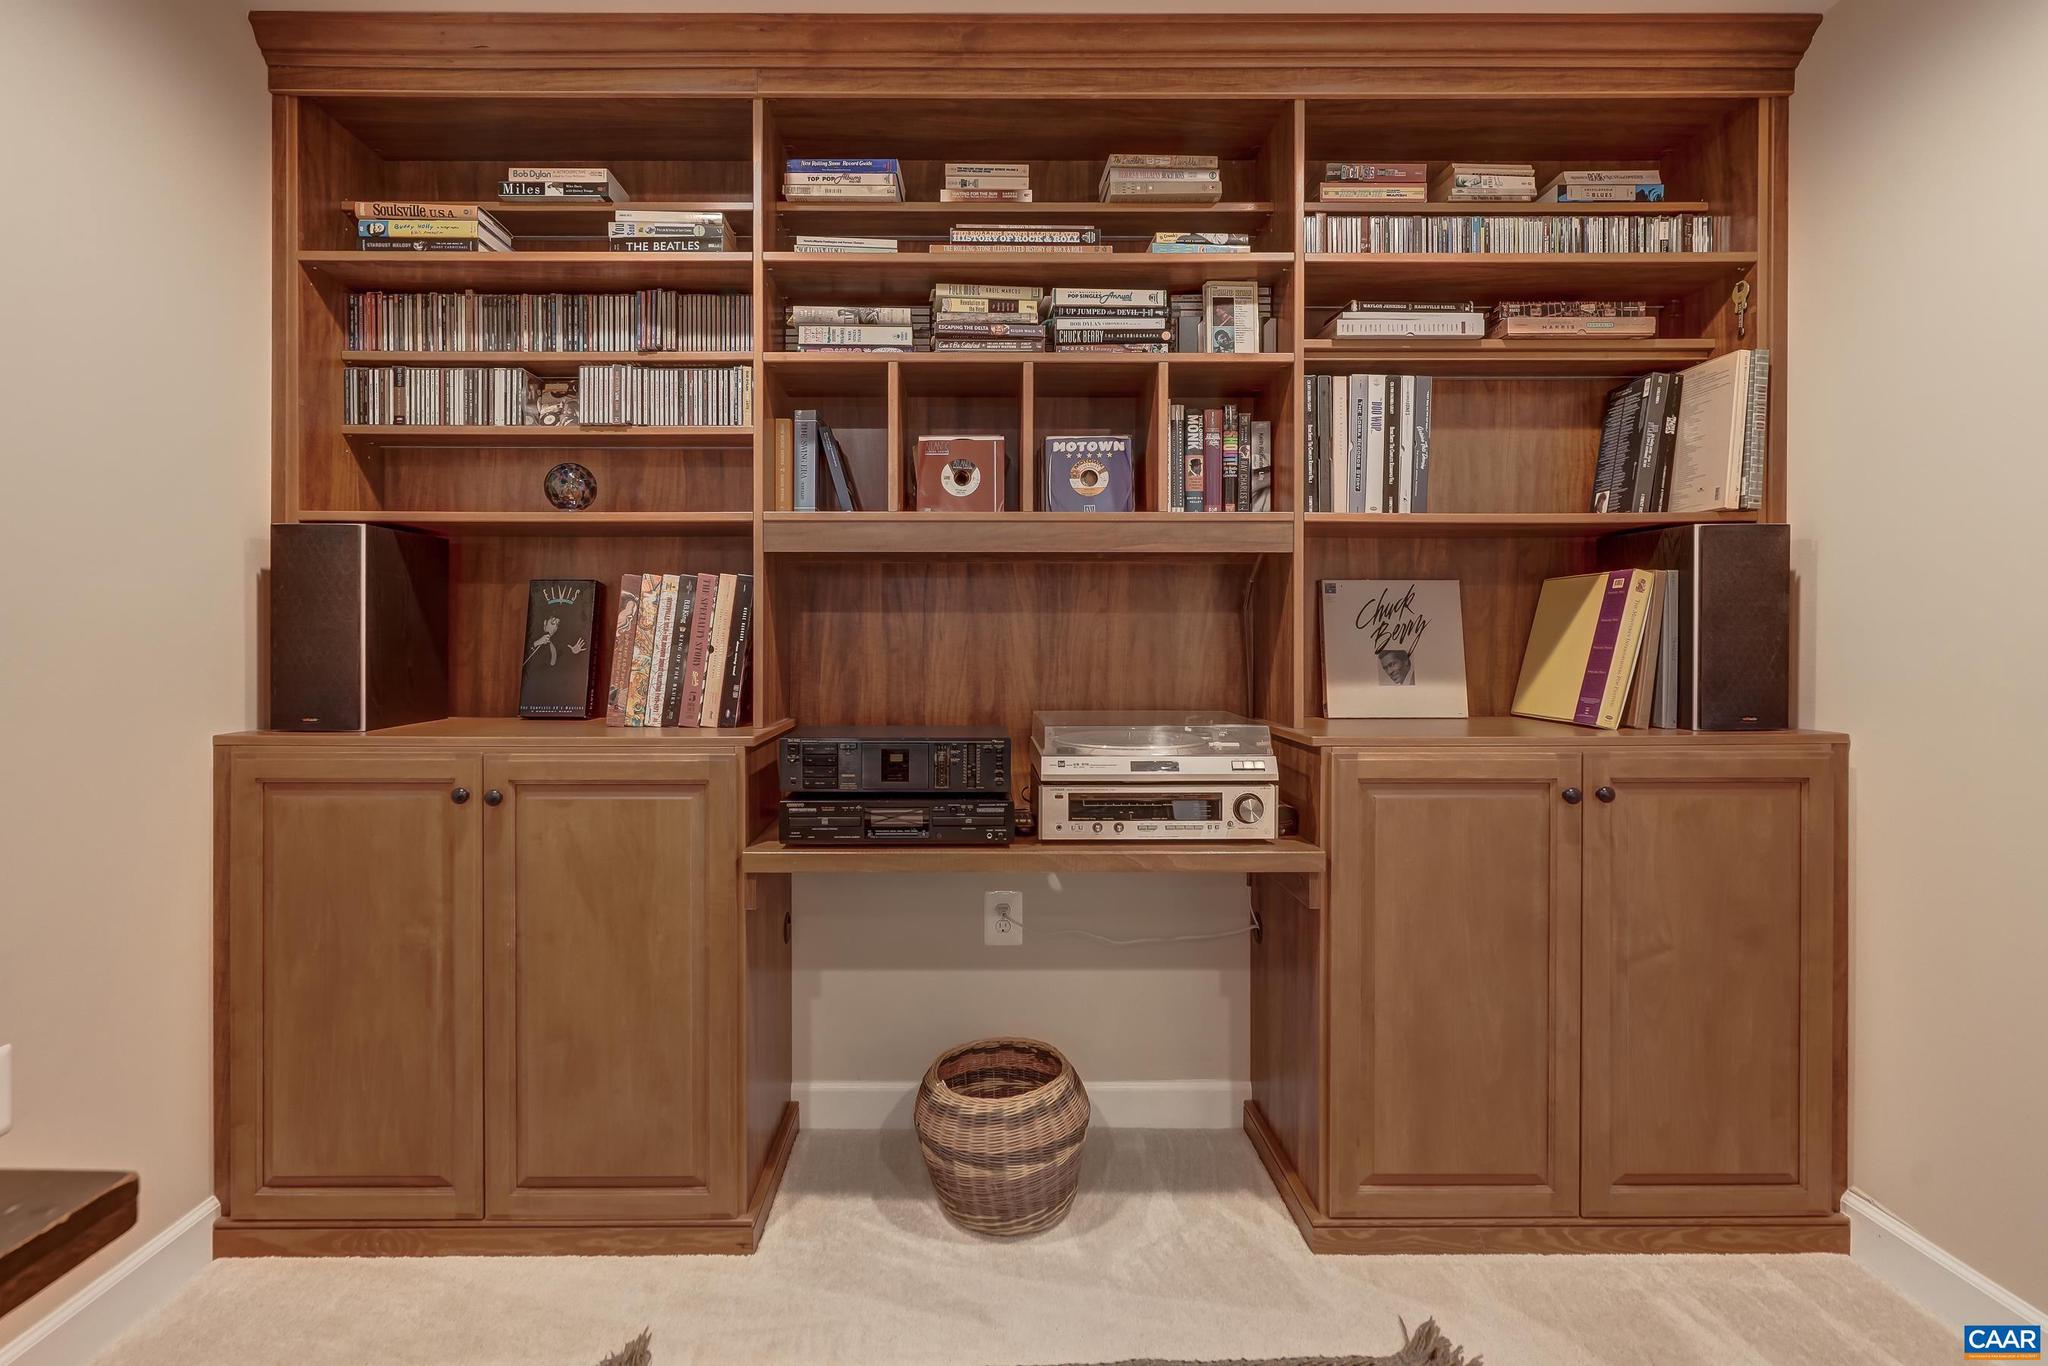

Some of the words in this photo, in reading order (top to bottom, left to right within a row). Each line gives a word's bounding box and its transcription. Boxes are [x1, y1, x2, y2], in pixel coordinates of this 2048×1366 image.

[512, 169, 529, 178] Bob
[529, 169, 552, 180] Dylan
[502, 183, 541, 195] Miles
[625, 242, 649, 251] THE
[653, 241, 700, 251] BEATLES
[1014, 235, 1043, 243] ROCK
[1059, 330, 1082, 343] CHUCK
[1082, 330, 1104, 343] BERRY
[800, 423, 808, 439] THE
[1370, 415, 1383, 432] WOP
[1187, 414, 1199, 450] MONK
[800, 440, 808, 463] SWING
[1052, 440, 1125, 452] MOTOWN
[1223, 430, 1238, 466] SHOUT!
[800, 464, 808, 480] ERA
[1240, 460, 1248, 471] RAY
[1240, 473, 1248, 499] CHARLES
[543, 584, 581, 601] ELVIS
[702, 579, 712, 593] THE
[1355, 583, 1416, 630] Chuck
[696, 596, 710, 640] SPECIALTY
[1370, 614, 1433, 658] Berry
[692, 640, 702, 668] STORY
